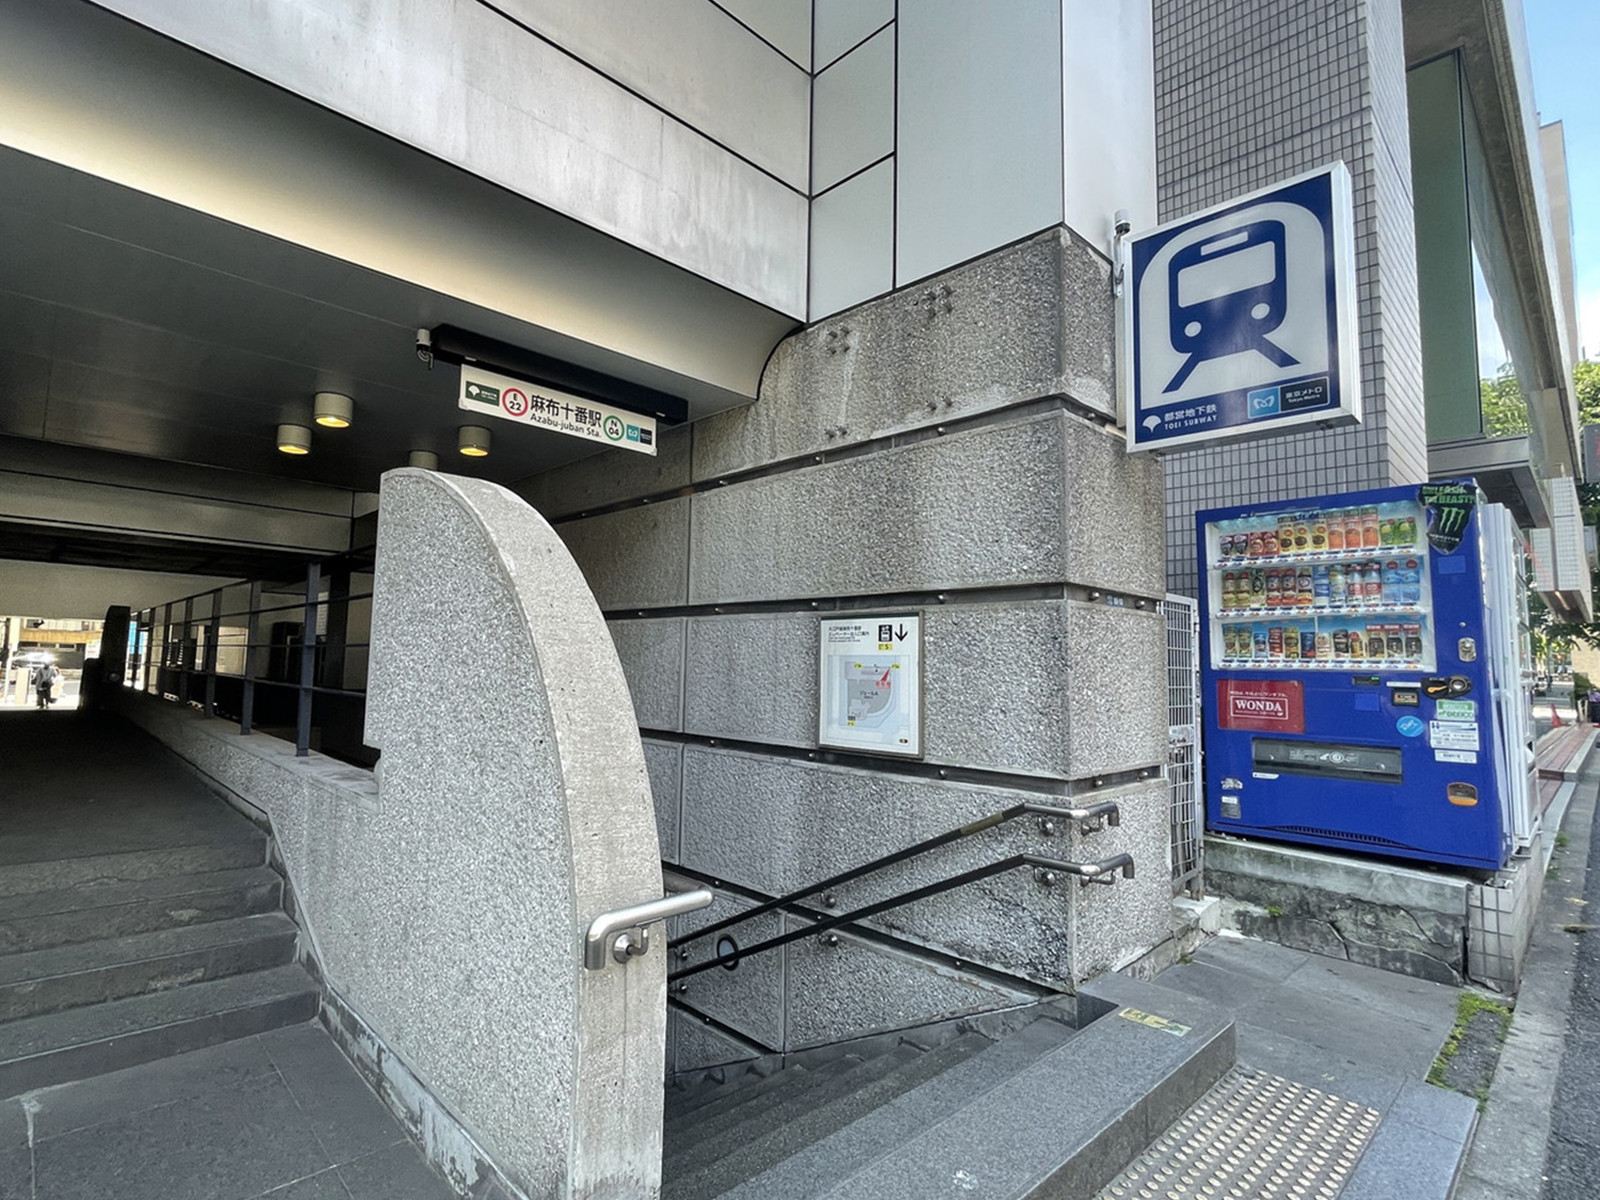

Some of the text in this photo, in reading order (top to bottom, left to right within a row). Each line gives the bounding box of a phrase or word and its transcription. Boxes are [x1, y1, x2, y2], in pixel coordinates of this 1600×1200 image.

[513, 393, 519, 402] E
[509, 400, 522, 412] 22
[530, 394, 602, 428] 麻布十番駅
[1164, 403, 1218, 422] 都営地下鉄
[530, 412, 602, 438] Azabu-juban Sta.
[610, 418, 618, 428] N
[1164, 414, 1218, 431] TOEI SUBWAY
[608, 426, 620, 436] 04
[1235, 699, 1284, 712] WONDA
